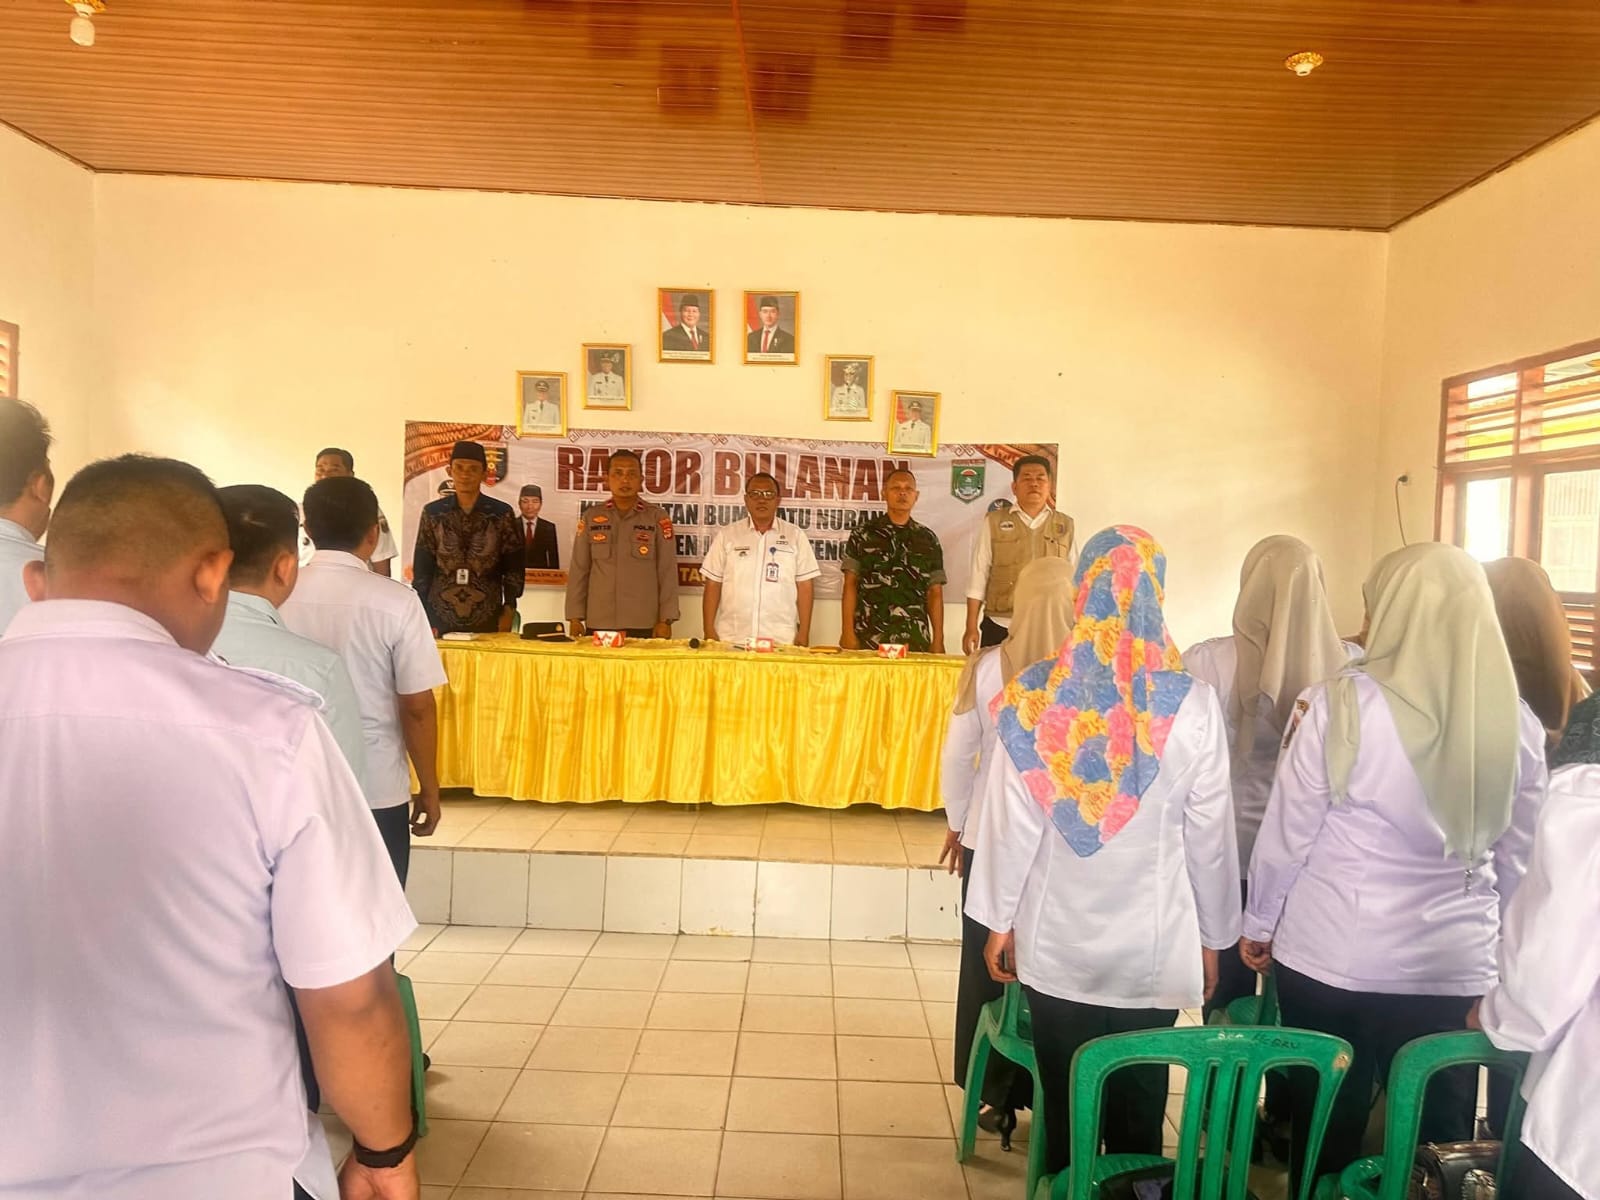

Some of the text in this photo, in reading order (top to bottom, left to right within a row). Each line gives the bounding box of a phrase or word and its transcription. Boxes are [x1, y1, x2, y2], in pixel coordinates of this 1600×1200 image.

[704, 504, 749, 526] BUM
[775, 507, 811, 530] ATU
[816, 508, 889, 530] NUBA
